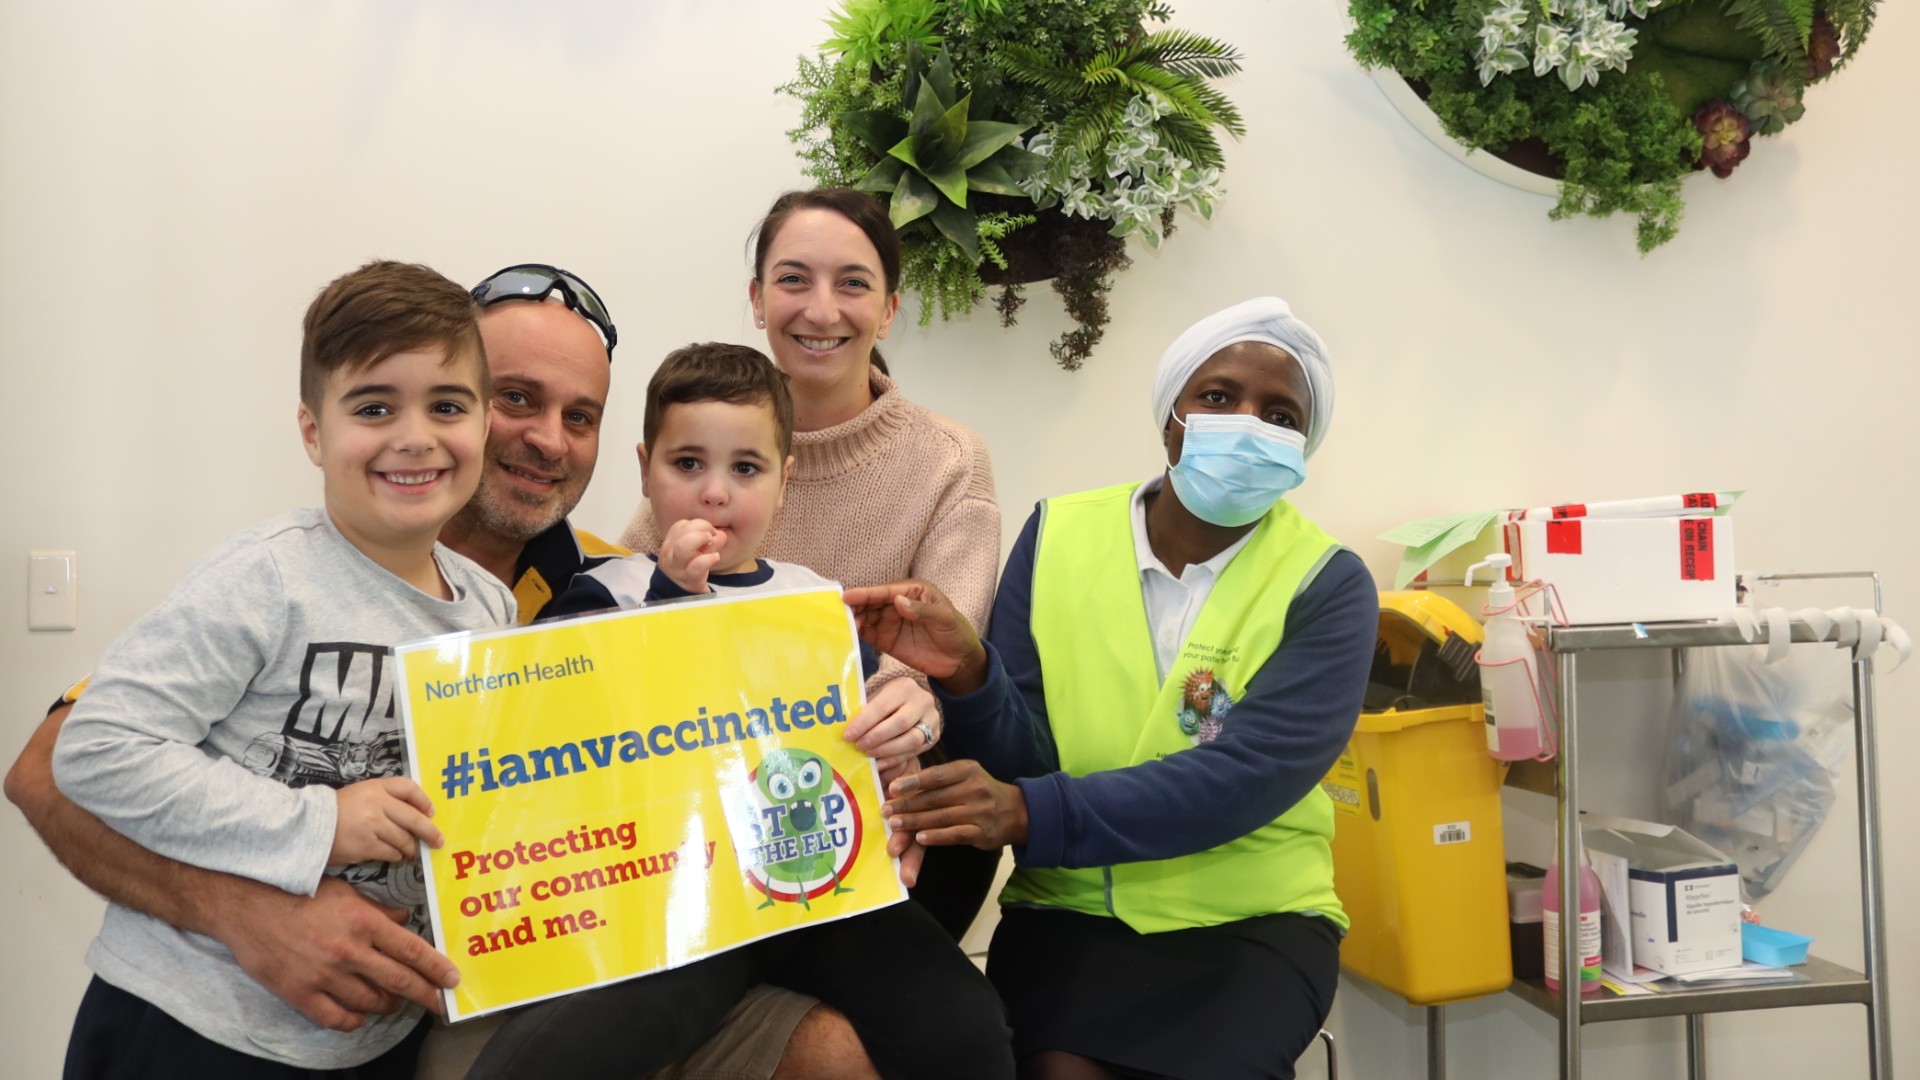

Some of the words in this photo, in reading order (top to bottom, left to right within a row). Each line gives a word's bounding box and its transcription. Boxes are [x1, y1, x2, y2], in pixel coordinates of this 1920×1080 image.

[1685, 528, 1694, 541] ON
[1697, 521, 1708, 551] CHAIN
[1187, 641, 1214, 652] Protect
[281, 642, 396, 745] MA
[425, 670, 521, 702] Northern
[523, 654, 595, 684] Health
[441, 684, 847, 800] #iamvaccinated
[749, 794, 845, 842] TOP
[802, 827, 848, 855] FLU
[452, 821, 637, 880] Protecting
[460, 884, 522, 917] our
[531, 841, 717, 901] communy
[467, 916, 537, 957] and
[543, 909, 607, 939] me.
